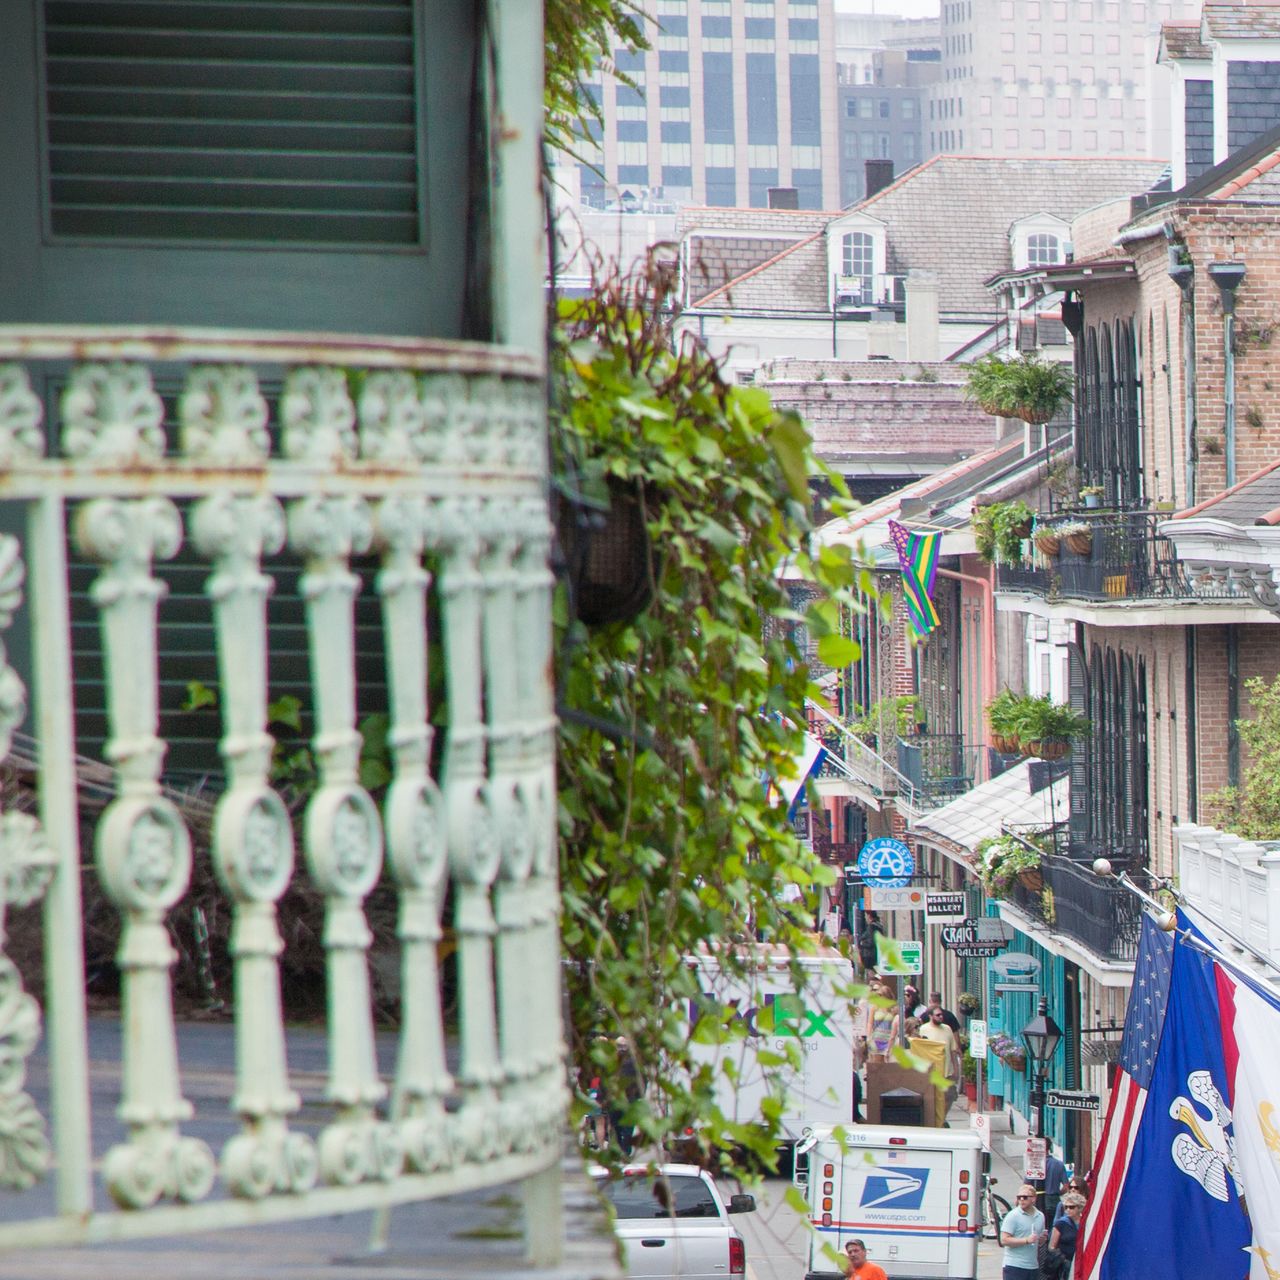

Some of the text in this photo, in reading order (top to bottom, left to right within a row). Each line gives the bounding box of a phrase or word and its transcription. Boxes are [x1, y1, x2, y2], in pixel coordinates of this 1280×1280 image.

[928, 905, 962, 913] GALLERY
[943, 927, 973, 943] CRAIG
[957, 949, 995, 957] GALLERY
[1049, 1094, 1100, 1110] Dumaine
[864, 1212, 927, 1223] www.usps.com
